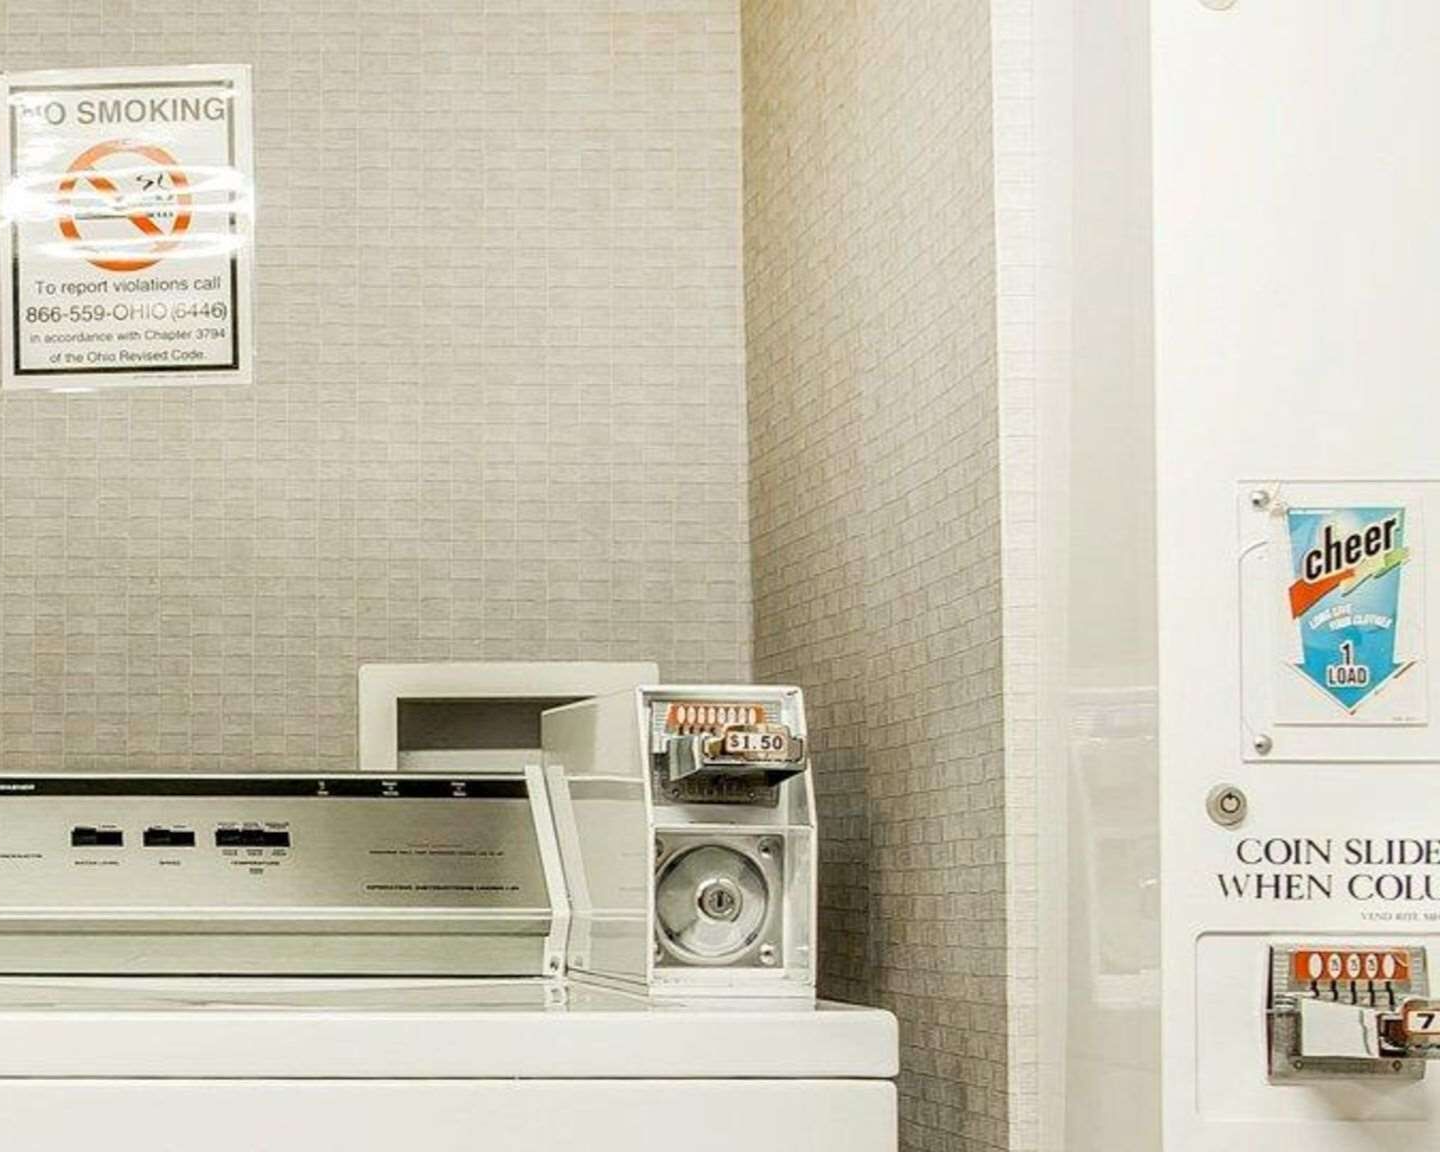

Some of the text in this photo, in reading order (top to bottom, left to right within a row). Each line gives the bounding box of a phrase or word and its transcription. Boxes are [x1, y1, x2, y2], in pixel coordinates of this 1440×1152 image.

[21, 97, 225, 125] O SMOKING
[35, 276, 221, 297] To report violations call
[30, 327, 226, 344] in accordance with Chapter 3794
[49, 352, 61, 363] of
[65, 352, 83, 363] the
[87, 350, 116, 362] Ohio
[119, 349, 168, 362] Revised
[1305, 517, 1397, 581] cheer
[1341, 643, 1351, 665] 1
[1328, 667, 1367, 685] LOAD
[729, 734, 783, 750] $1.50
[1237, 838, 1440, 865] COIN SLIDE
[1217, 873, 1333, 900] WHEN
